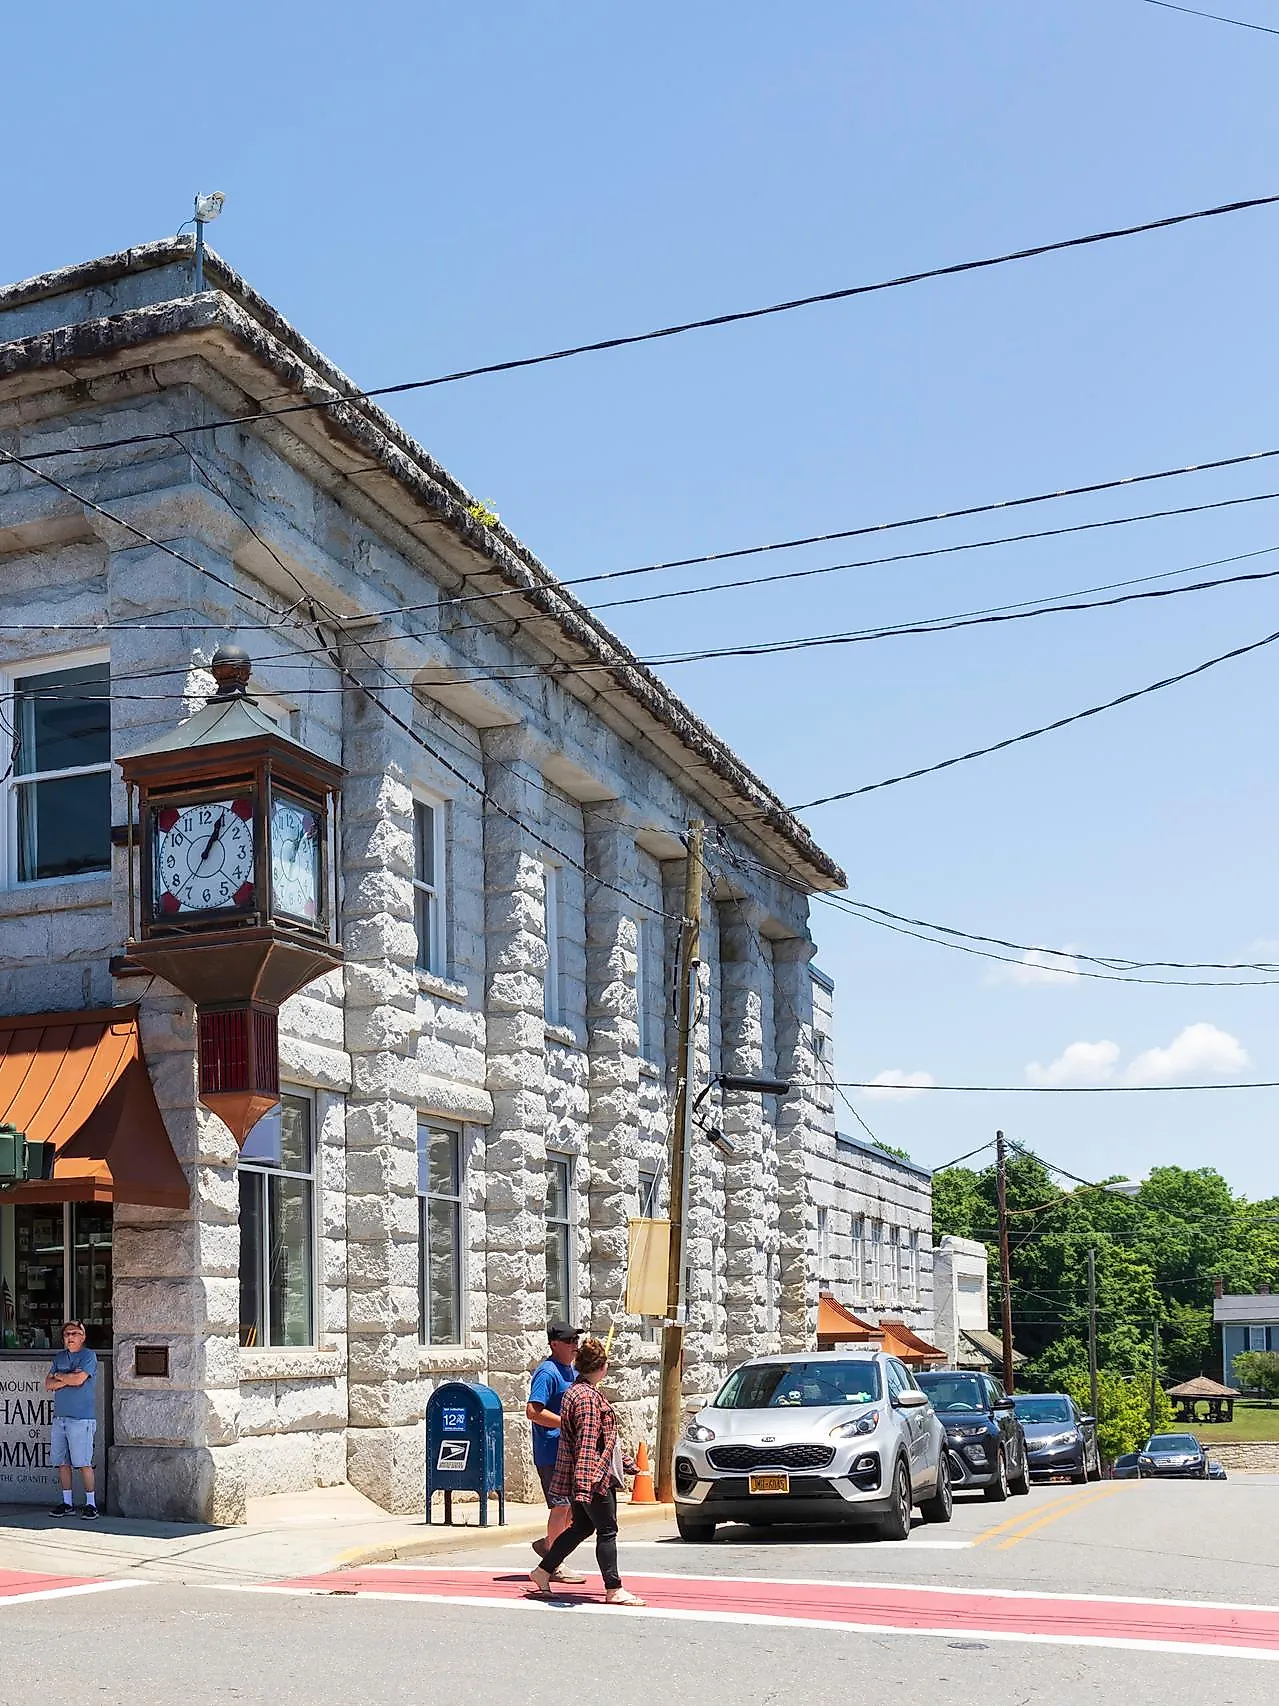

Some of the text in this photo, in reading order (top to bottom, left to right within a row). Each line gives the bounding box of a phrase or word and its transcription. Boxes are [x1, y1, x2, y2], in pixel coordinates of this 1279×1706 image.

[199, 810, 212, 825] 12
[286, 813, 294, 829] 12
[184, 818, 193, 832] 11
[171, 833, 184, 847] 10
[232, 826, 241, 840] 2
[237, 845, 247, 860] 3
[166, 854, 176, 869] 9
[232, 865, 242, 880] 4
[172, 873, 181, 887] 8
[185, 886, 193, 900] 7
[202, 888, 211, 903] 6
[219, 881, 229, 896] 5
[0, 1380, 41, 1392] MOUNT
[443, 1414, 457, 1426] 12
[28, 1428, 41, 1439] OF
[1, 1474, 13, 1482] THE
[17, 1475, 49, 1484] GRANITE
